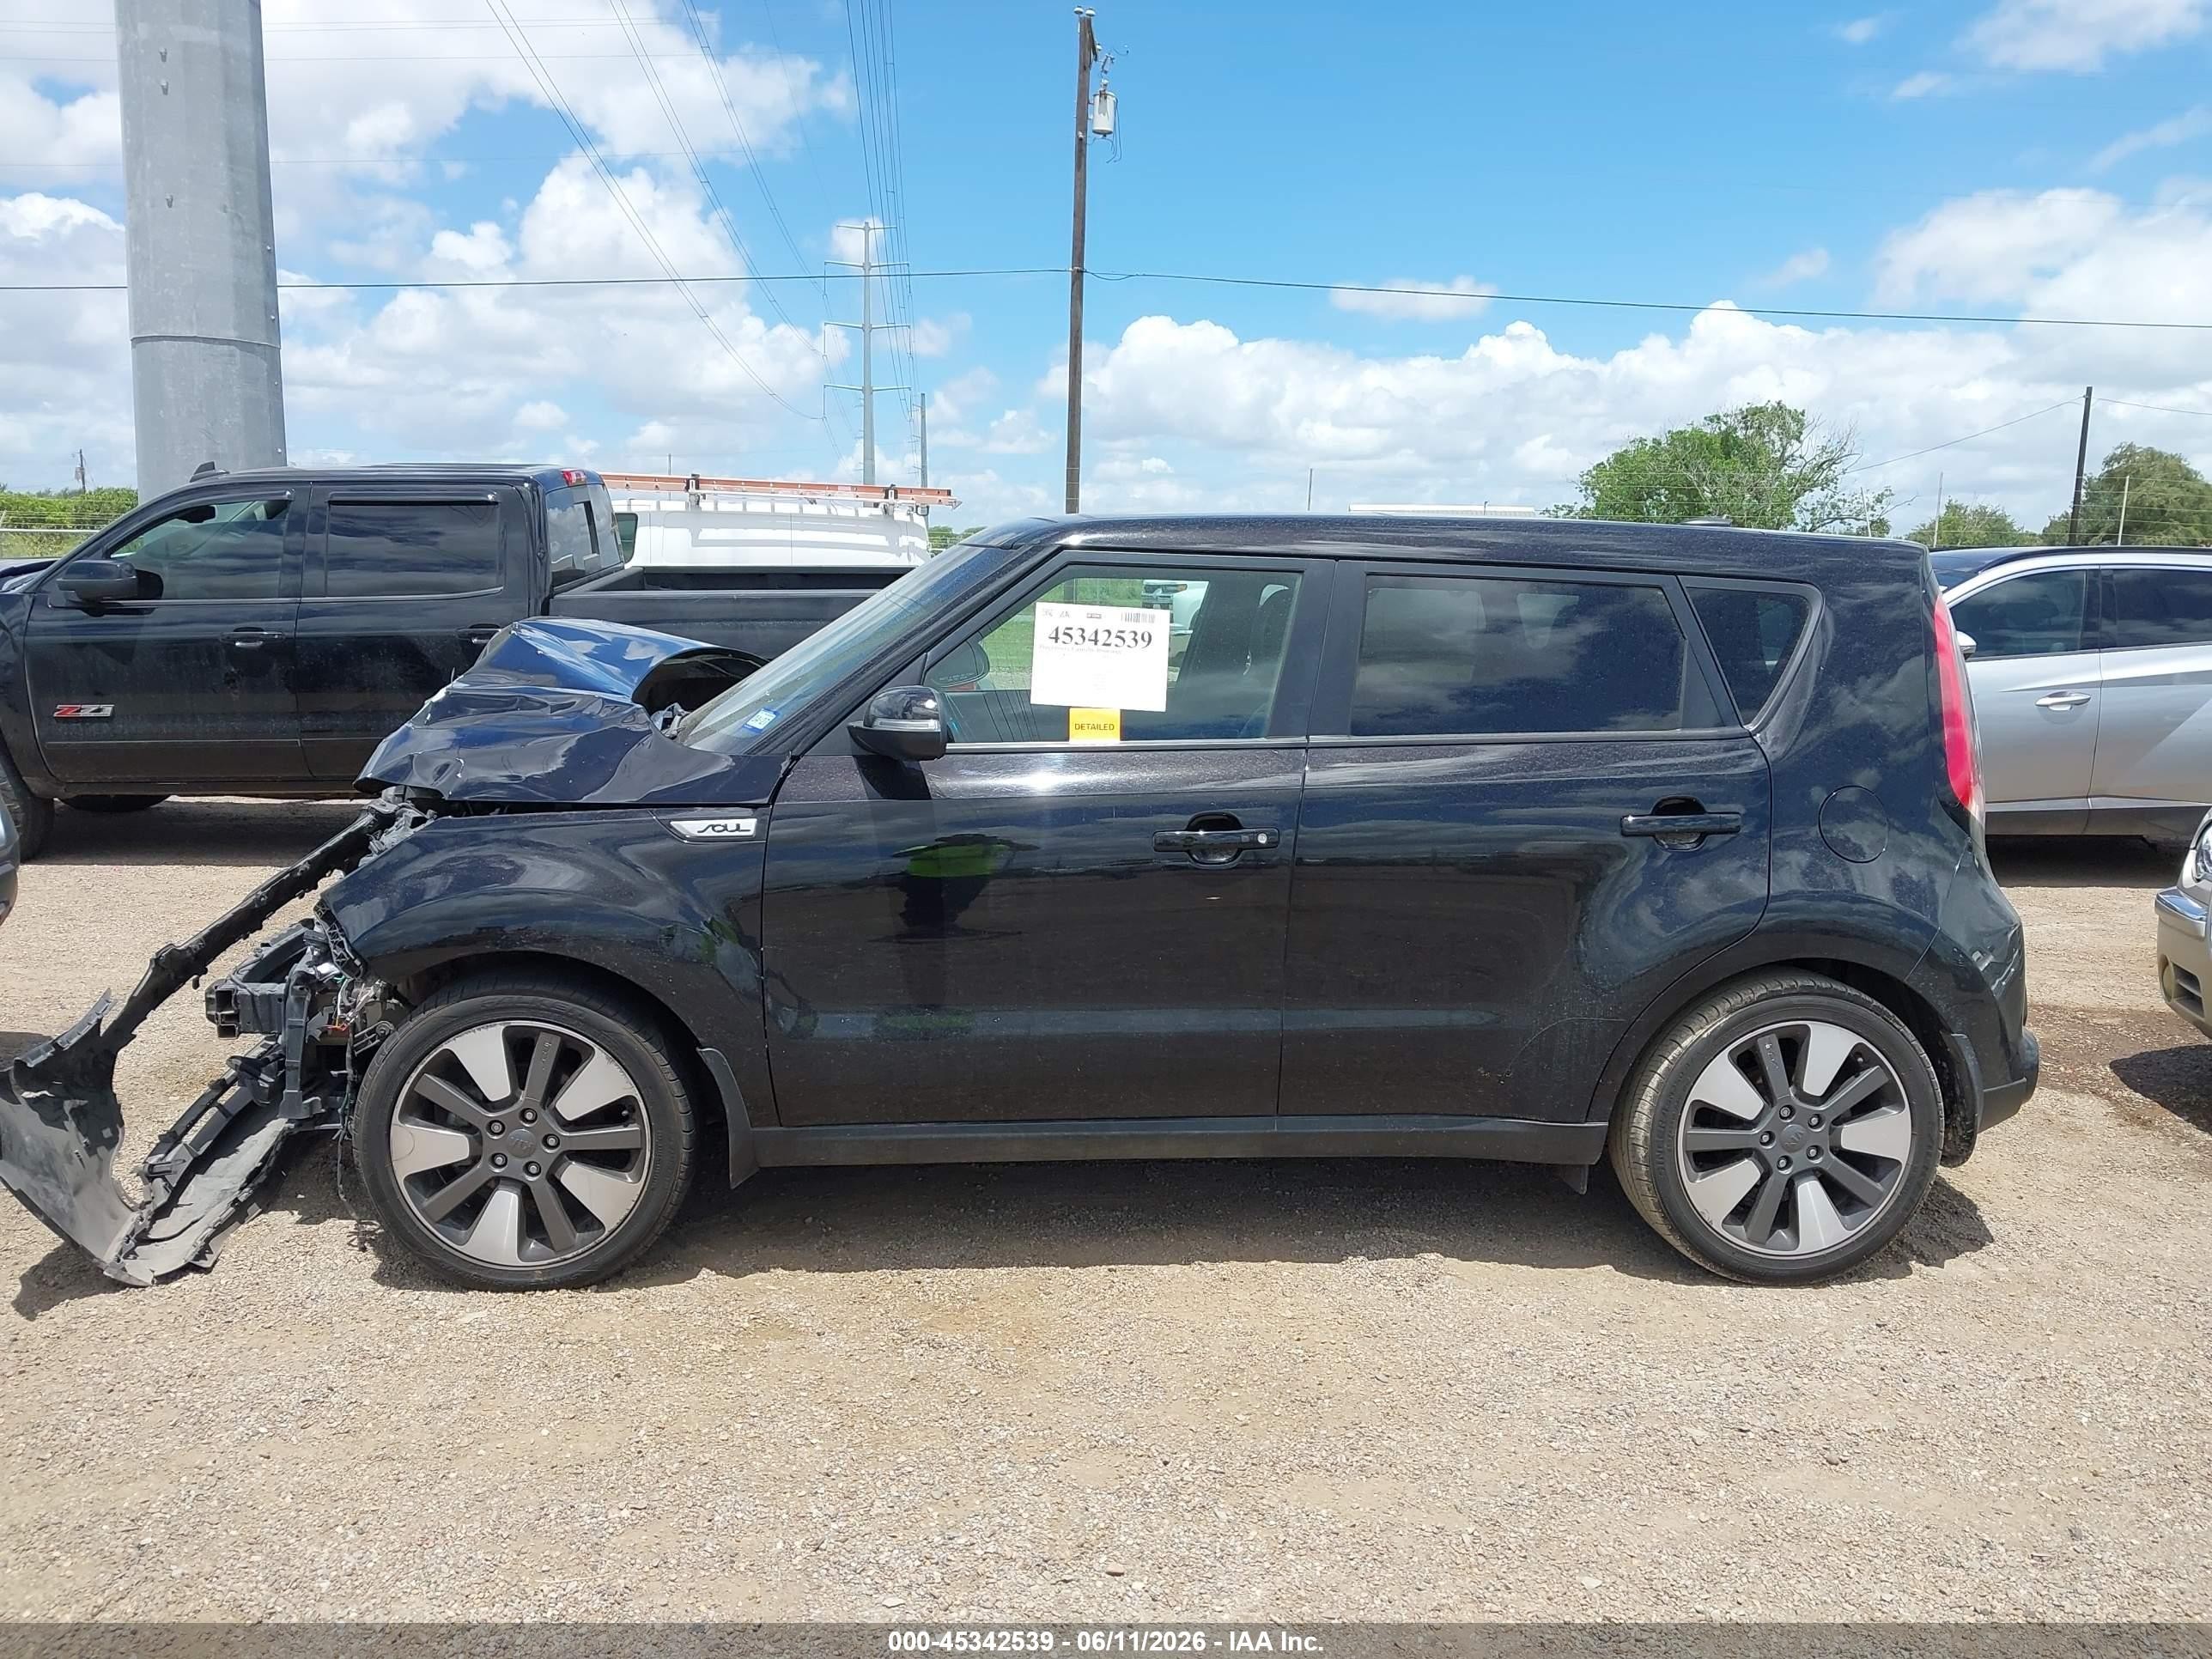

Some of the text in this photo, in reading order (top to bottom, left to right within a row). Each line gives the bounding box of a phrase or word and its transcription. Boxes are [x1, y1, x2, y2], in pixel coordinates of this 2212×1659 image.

[1048, 625, 1152, 649] 45342539
[53, 704, 115, 717] Z71
[1074, 722, 1115, 731] DETAILED
